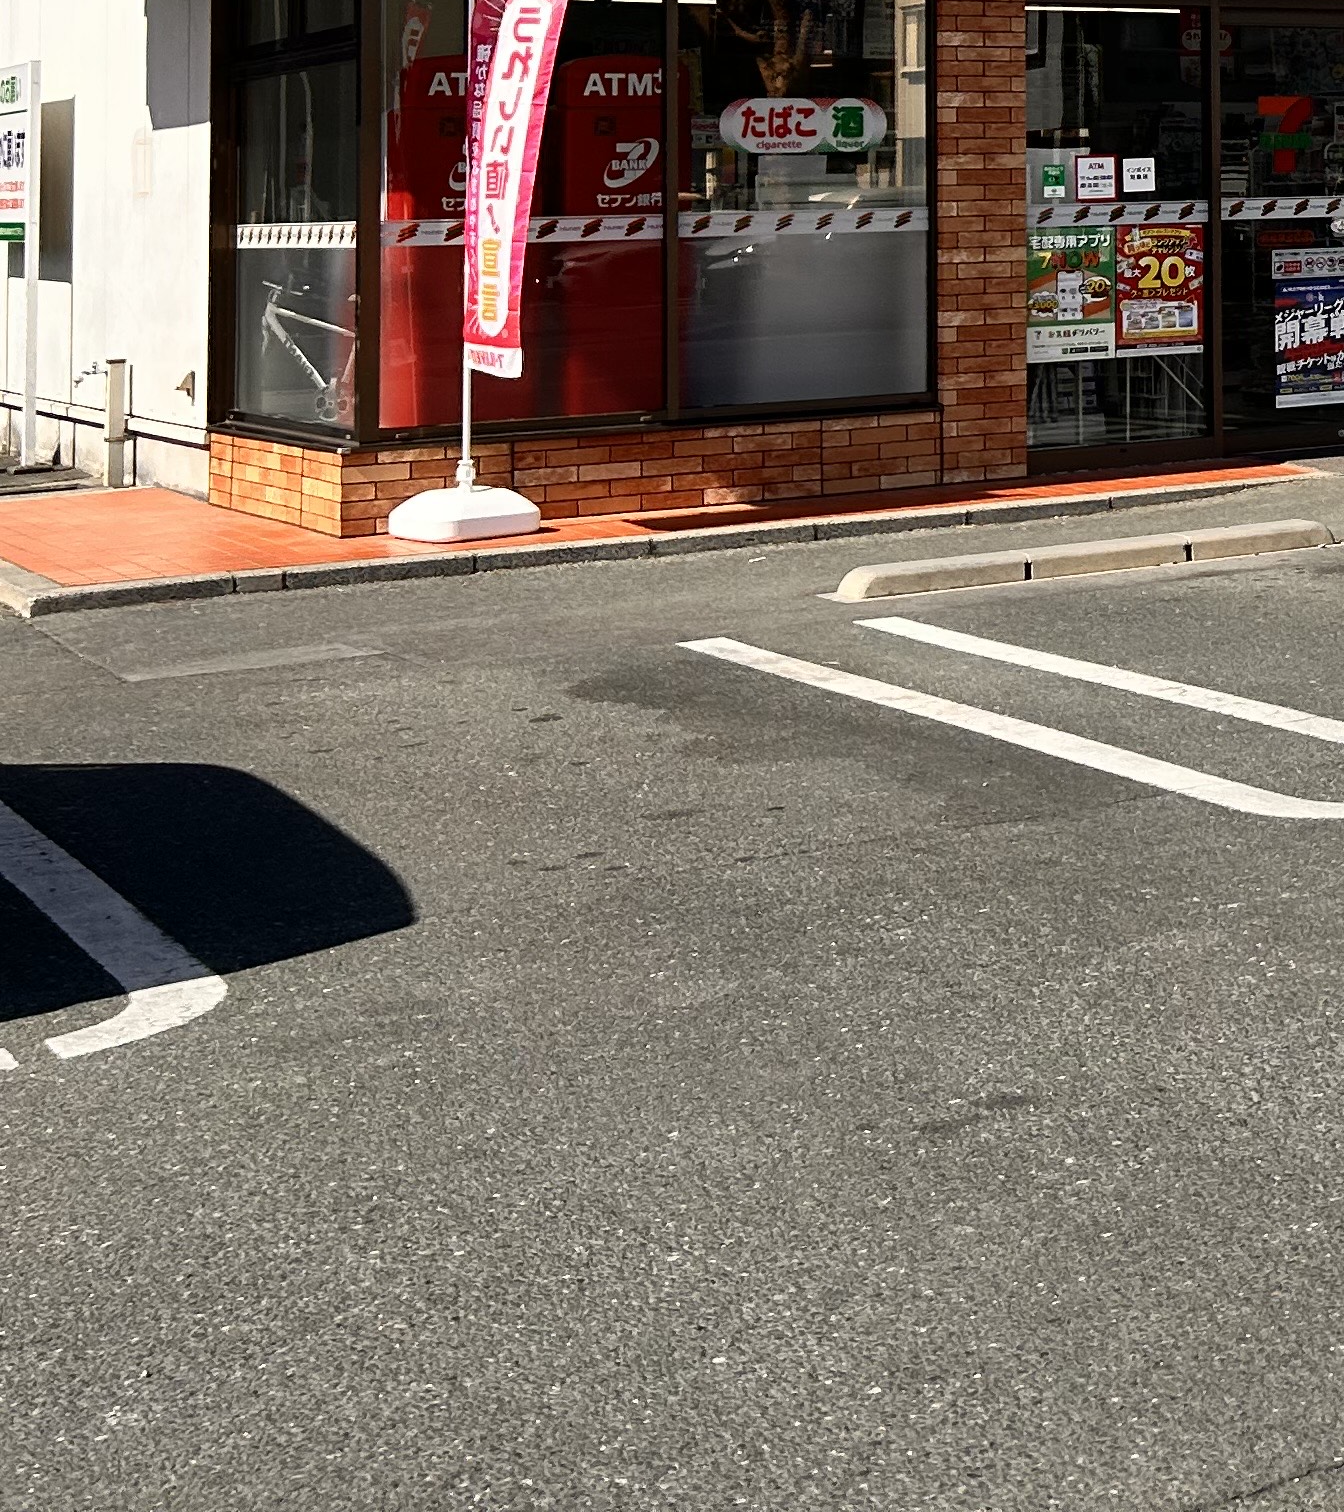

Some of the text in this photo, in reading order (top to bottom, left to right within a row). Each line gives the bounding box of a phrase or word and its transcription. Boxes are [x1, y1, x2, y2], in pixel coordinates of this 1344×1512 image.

[428, 73, 468, 96] AT
[583, 73, 652, 96] ATM
[741, 105, 817, 138] たばこ
[832, 106, 865, 138] 酒
[756, 140, 803, 150] cigarette
[835, 140, 865, 149] liquor
[1088, 162, 1105, 170] ATM
